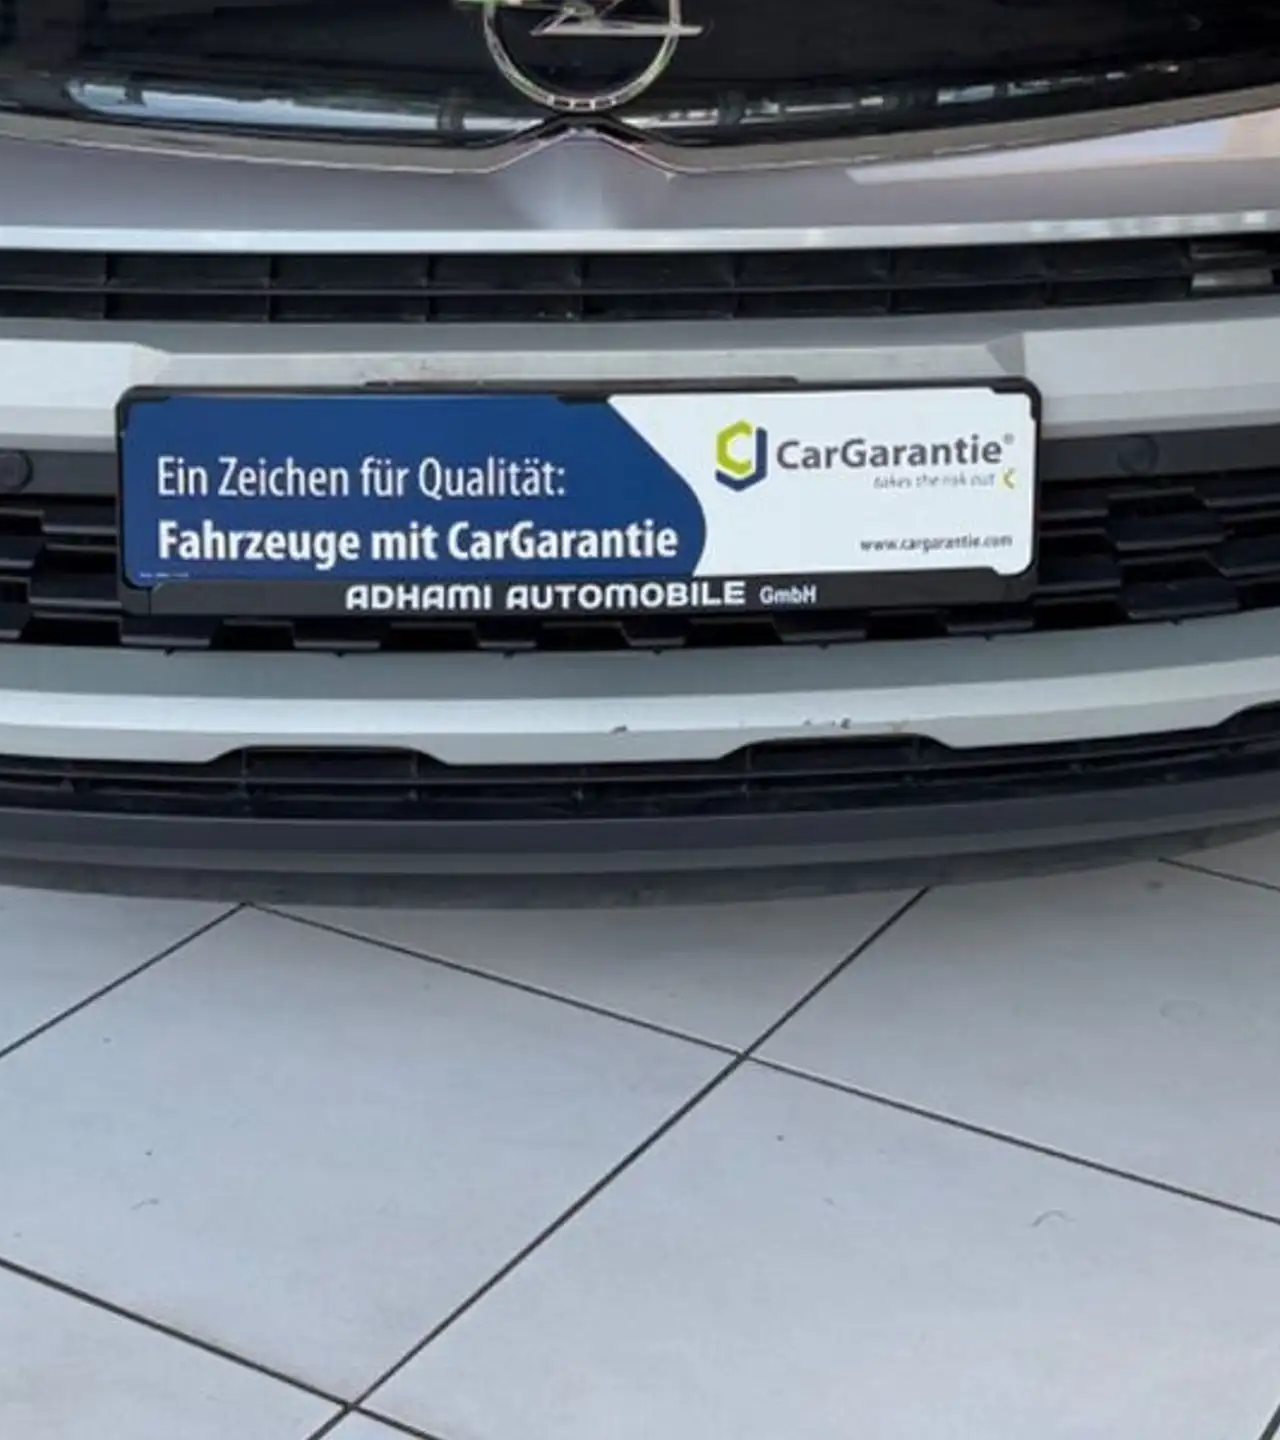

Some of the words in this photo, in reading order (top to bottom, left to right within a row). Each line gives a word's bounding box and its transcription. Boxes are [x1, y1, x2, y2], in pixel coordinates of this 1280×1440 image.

[157, 455, 208, 496] Ein
[217, 455, 350, 497] Zeichen
[359, 455, 410, 497] für
[418, 455, 566, 500] Qualität:
[158, 519, 361, 571] Fahrzeuge
[371, 519, 439, 560] mit
[447, 518, 679, 560] CarGarantie
[860, 533, 1014, 554] www.cargarantie.com
[345, 584, 492, 610] ADHAMI
[506, 581, 746, 610] AUTOMOBILE
[759, 584, 817, 605] GmbH
